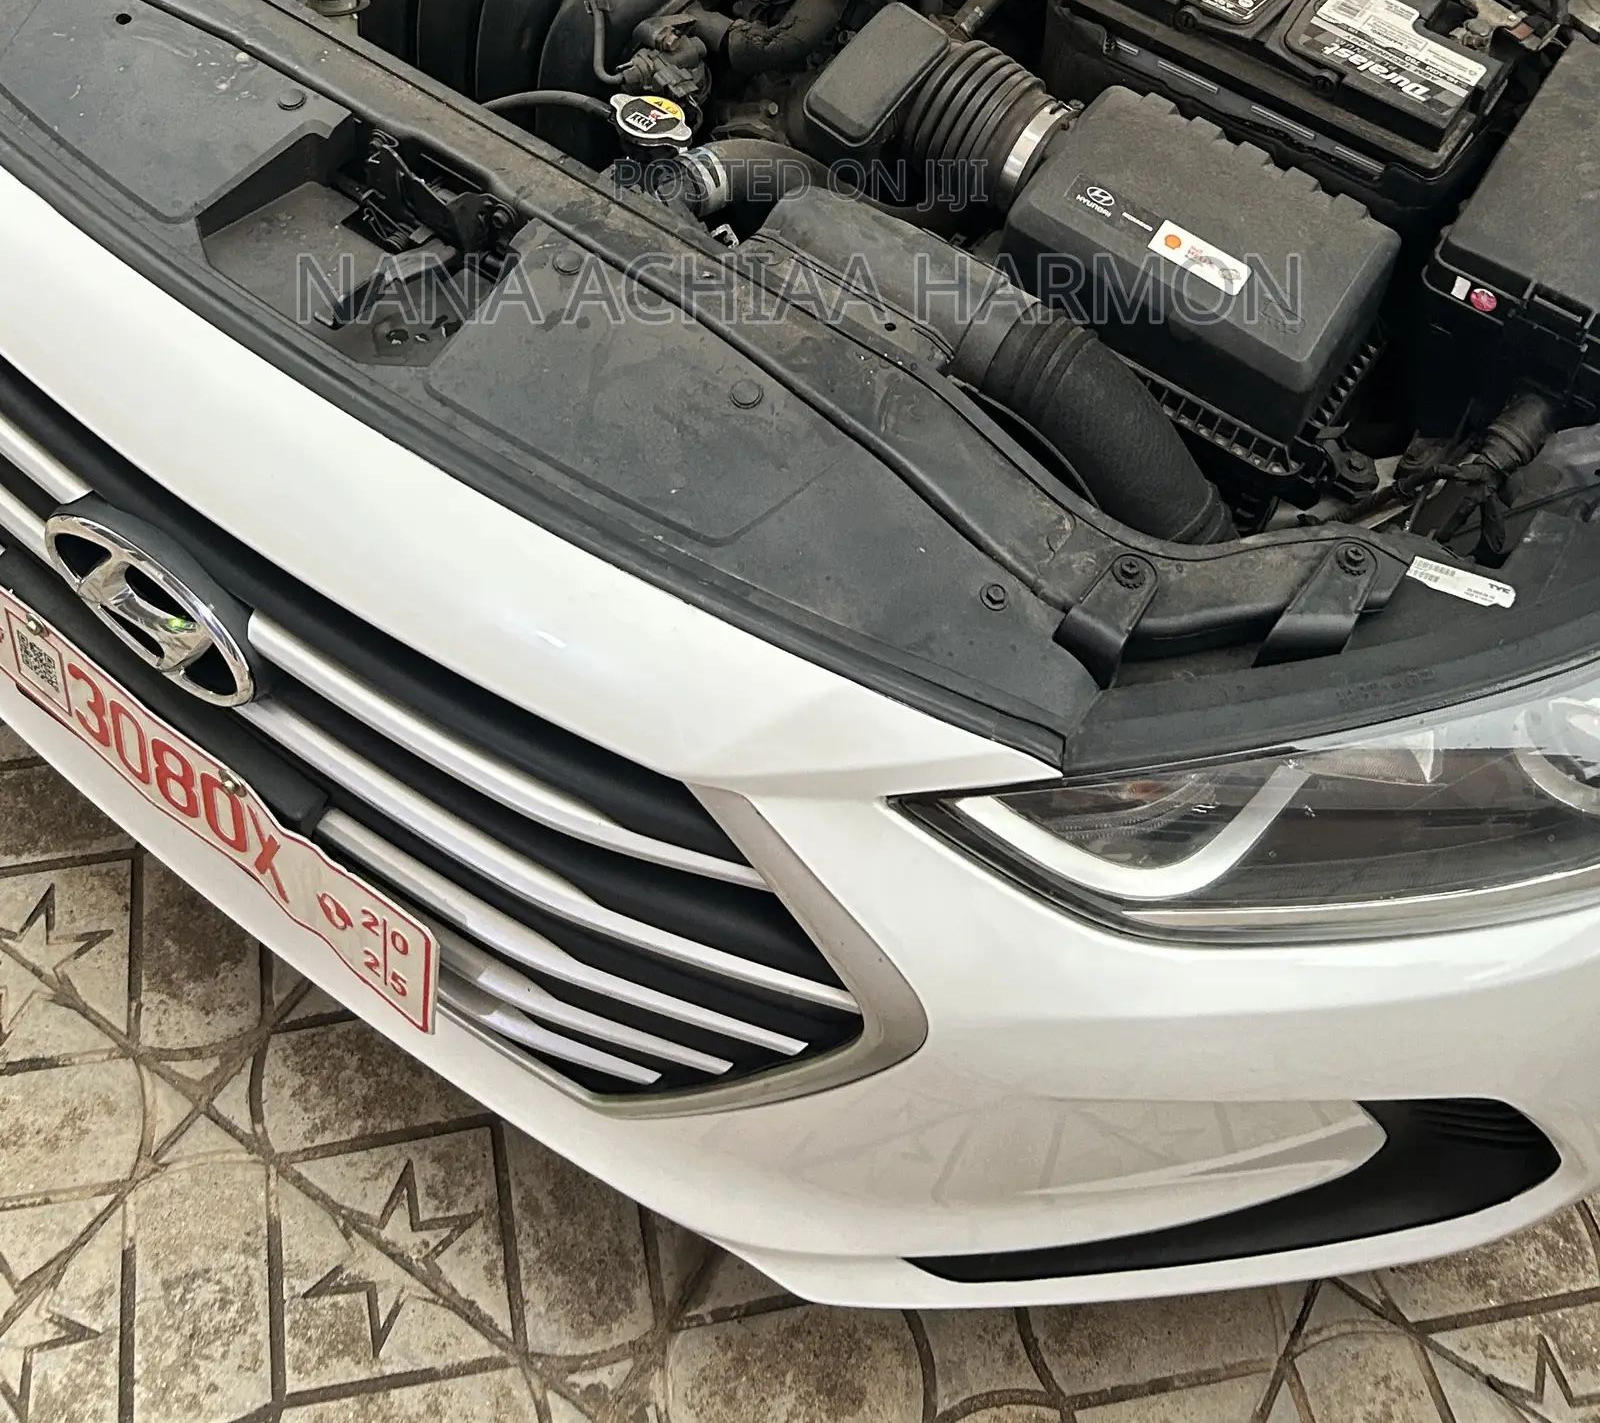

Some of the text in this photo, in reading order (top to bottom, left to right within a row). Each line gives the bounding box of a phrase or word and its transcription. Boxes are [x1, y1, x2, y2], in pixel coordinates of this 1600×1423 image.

[1334, 36, 1398, 71] PLATINUM
[1343, 31, 1412, 70] TECHNOLOGY
[1321, 38, 1432, 102] Duralast
[1076, 194, 1111, 218] HYUNDAI
